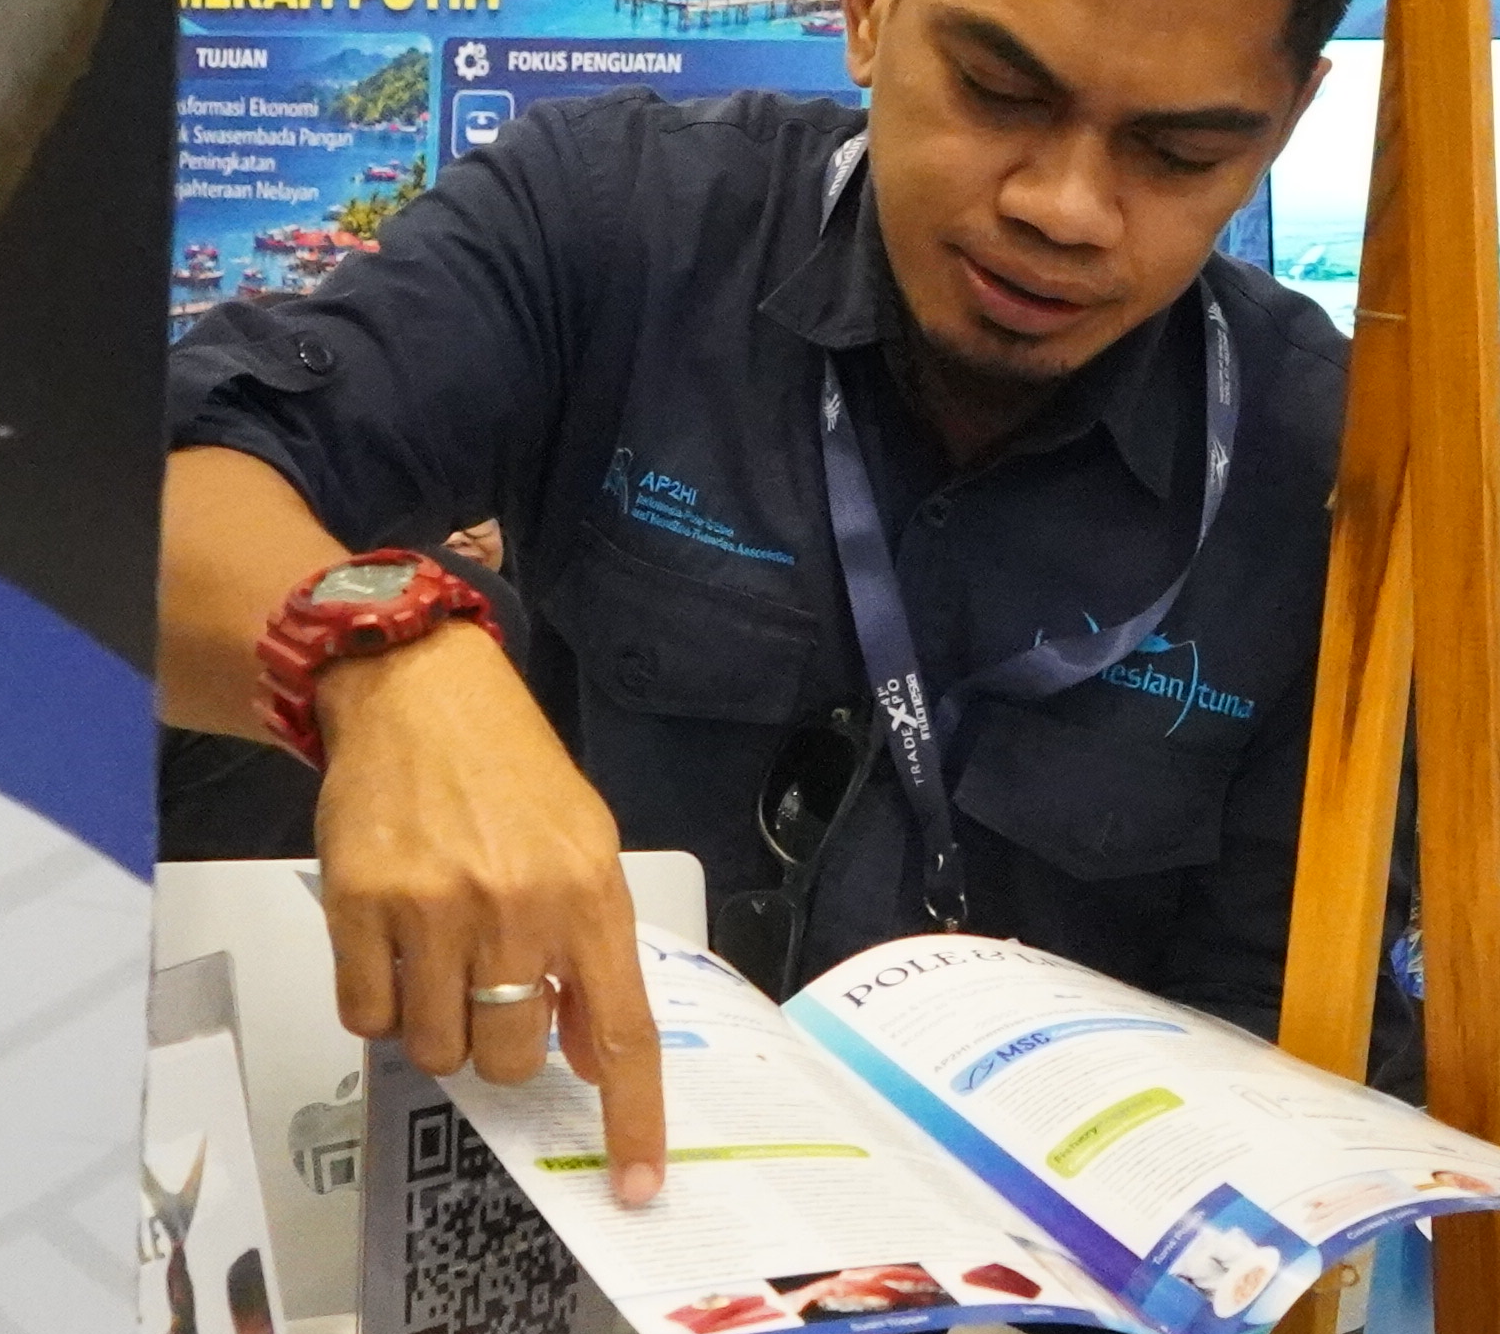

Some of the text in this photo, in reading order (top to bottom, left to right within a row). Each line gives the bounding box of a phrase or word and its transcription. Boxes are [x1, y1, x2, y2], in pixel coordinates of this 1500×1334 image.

[196, 47, 268, 68] TUJUAN
[508, 51, 682, 74] FOKUS PENGUATAN
[250, 97, 320, 118] Ekonomi
[174, 179, 320, 206] jahteraan Nelayan
[639, 471, 699, 506] AP2HI
[1102, 663, 1256, 718] esian tuna
[842, 950, 967, 1010] POLE
[995, 1032, 1051, 1063] MSC
